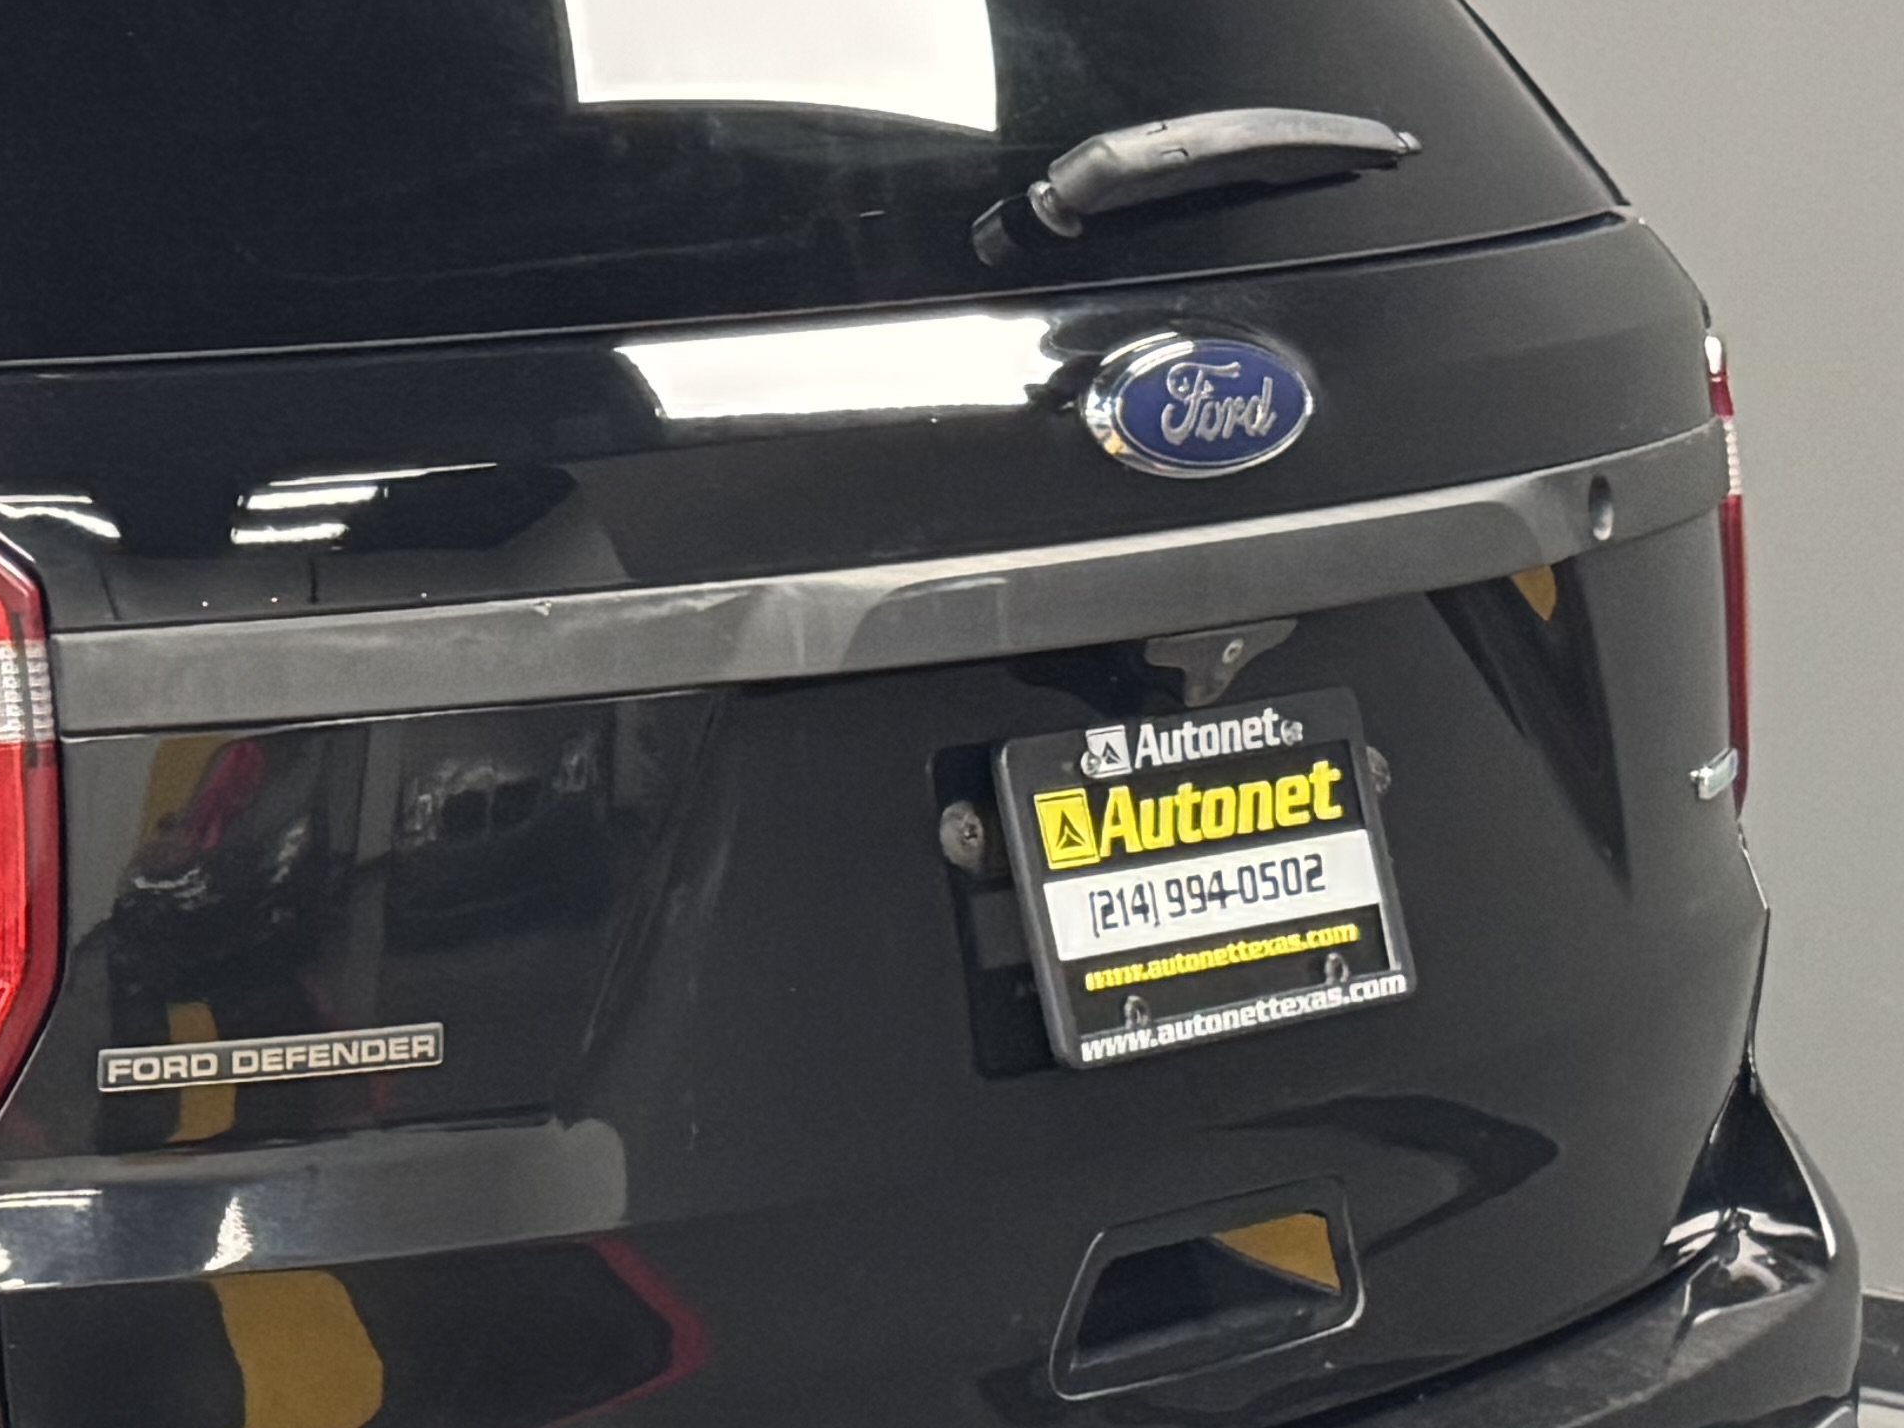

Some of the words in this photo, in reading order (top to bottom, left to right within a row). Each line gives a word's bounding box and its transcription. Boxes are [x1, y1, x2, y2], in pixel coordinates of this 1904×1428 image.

[1160, 361, 1278, 446] Ford
[1133, 707, 1282, 770] Autonet
[1099, 759, 1344, 858] Autonet
[1088, 878, 1161, 938] (214)
[1166, 853, 1327, 919] 994-0502
[1085, 921, 1361, 992] www.autonettexas.com
[107, 1052, 218, 1084] FORD
[231, 1034, 435, 1075] DEFENDER
[1080, 972, 1408, 1062] www.autonettexas.com
